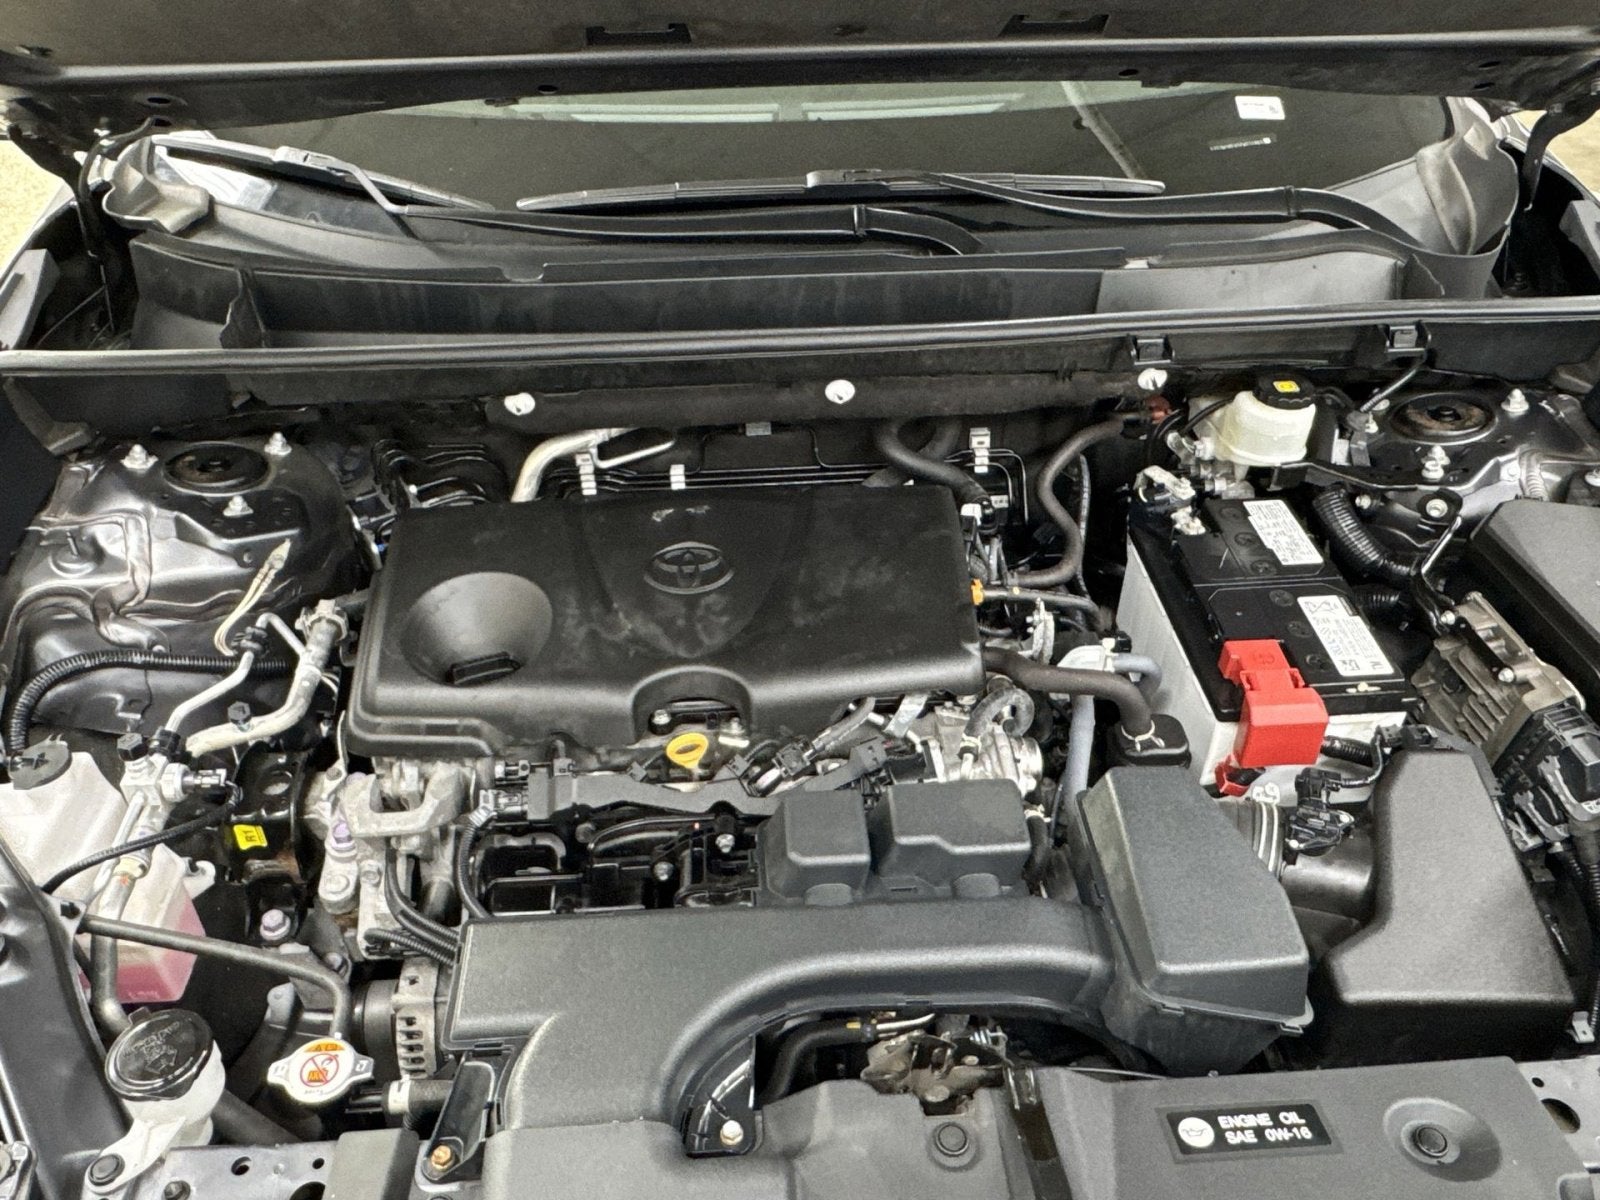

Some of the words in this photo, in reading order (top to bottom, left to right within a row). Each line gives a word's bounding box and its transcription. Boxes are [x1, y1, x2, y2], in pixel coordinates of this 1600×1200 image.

[1217, 1113, 1273, 1129] ENGINE
[1279, 1111, 1306, 1125] OIL
[1224, 1130, 1258, 1145] SAE
[1264, 1126, 1313, 1142] 0W-16
